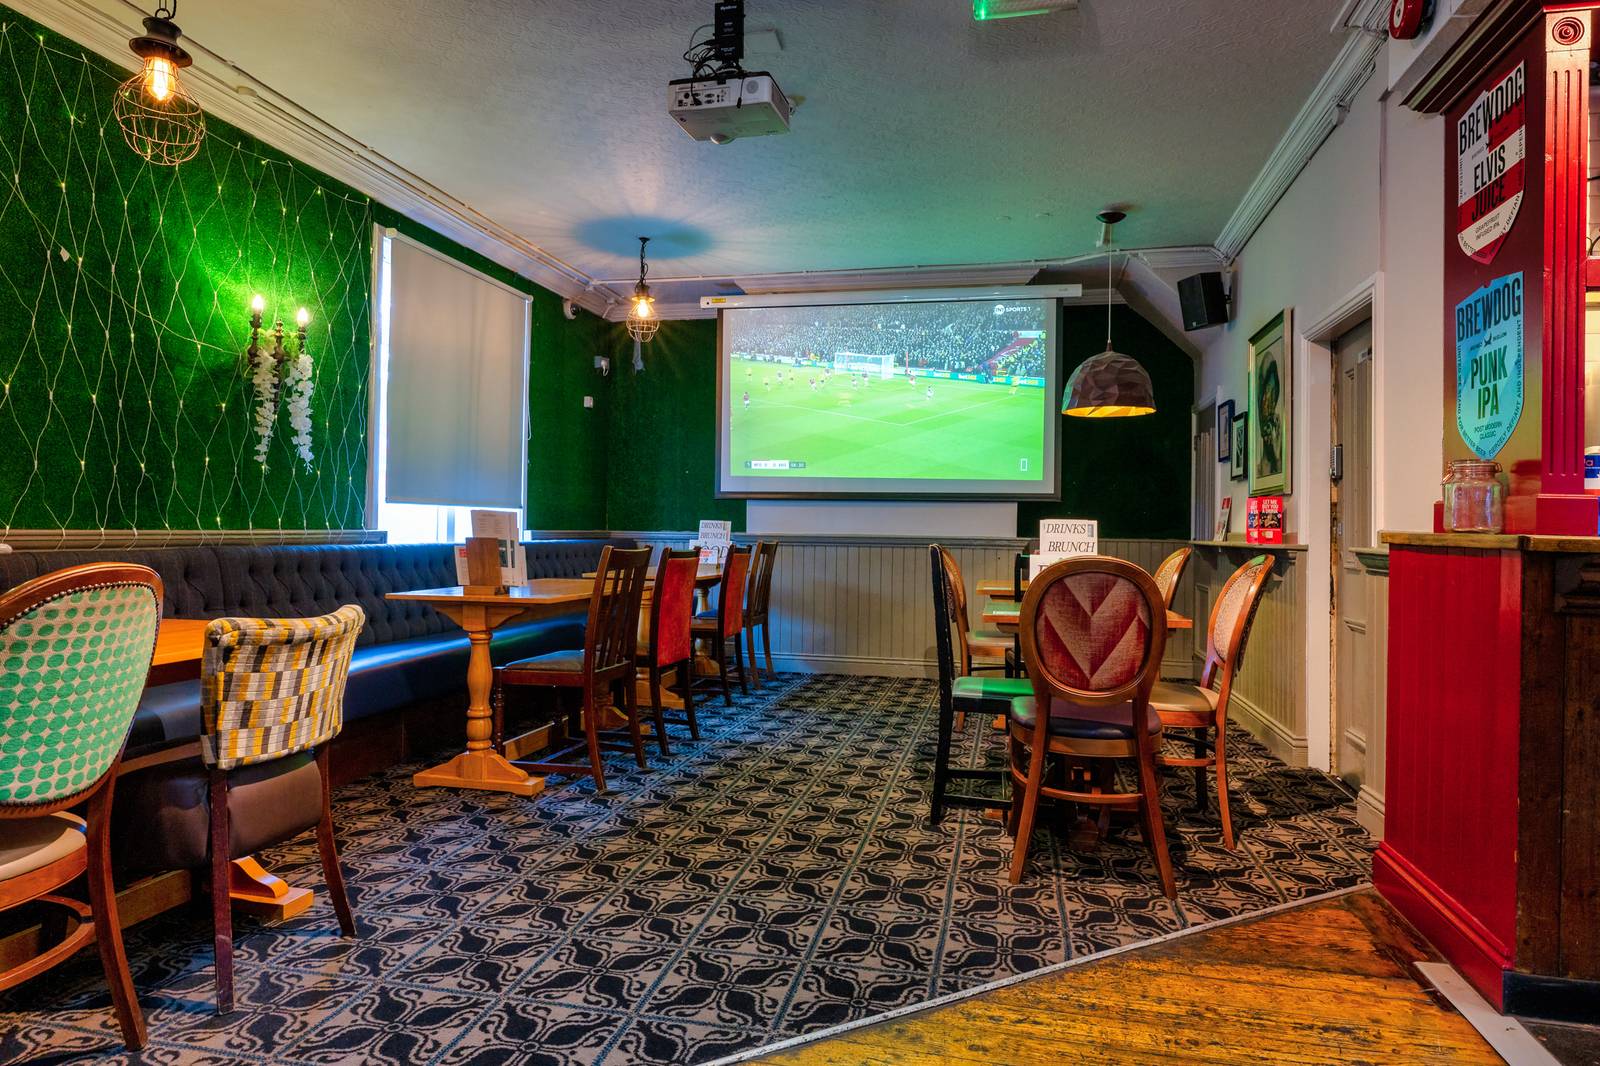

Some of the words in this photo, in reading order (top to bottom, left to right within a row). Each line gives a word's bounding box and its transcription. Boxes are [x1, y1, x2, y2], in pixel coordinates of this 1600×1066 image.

[1460, 67, 1522, 155] BREWDOG
[1474, 144, 1505, 192] ELVIS
[1472, 174, 1505, 222] JUICE
[1457, 278, 1520, 342] BREWDOG
[1471, 345, 1508, 389] PUNK
[1478, 383, 1499, 419] IPA
[1507, 400, 1521, 432] DEFIANT
[1046, 523, 1087, 534] DRINKS
[1048, 541, 1096, 552] BRUNCH
